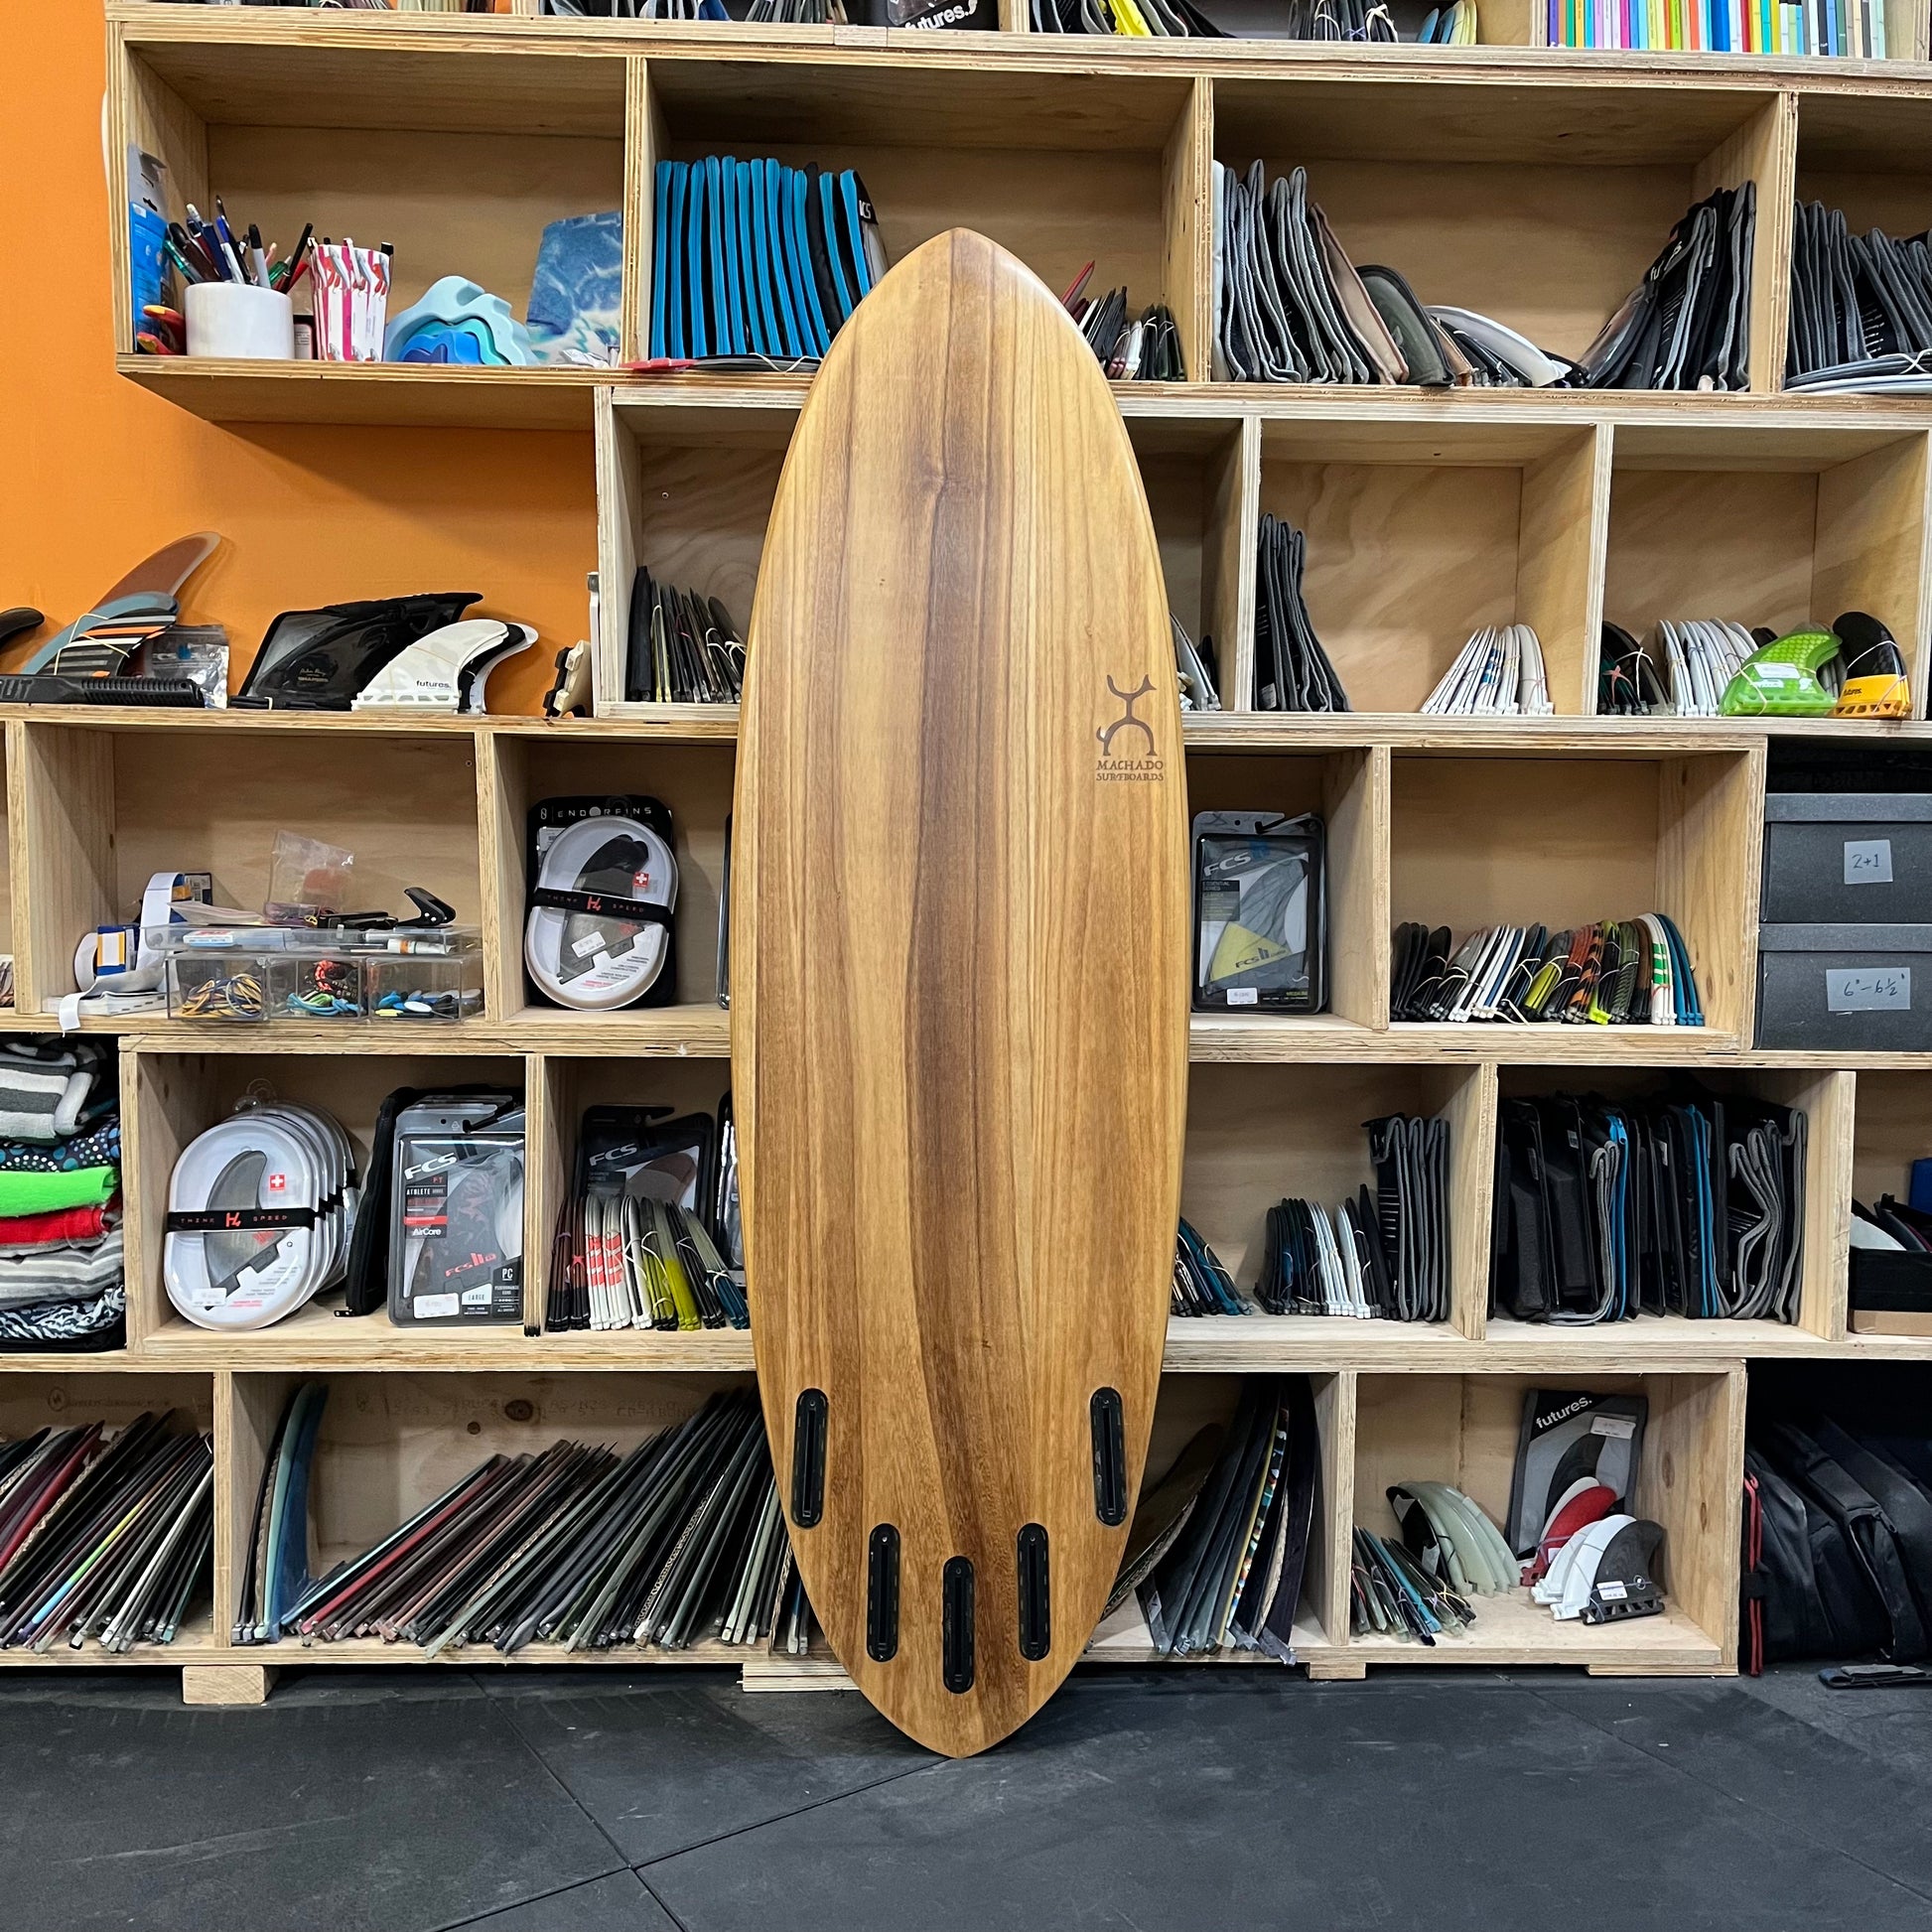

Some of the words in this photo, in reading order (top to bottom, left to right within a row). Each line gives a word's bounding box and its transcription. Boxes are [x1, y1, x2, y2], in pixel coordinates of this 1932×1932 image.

[1096, 759, 1164, 770] MACHADO
[1096, 772, 1164, 781] SURFBOARDS
[1203, 852, 1251, 877] FCS
[1852, 854, 1879, 869] 2+1
[589, 1144, 637, 1167] FCS
[404, 1153, 458, 1180] FCS
[412, 1227, 442, 1236] AirCore
[501, 1268, 513, 1279] PC
[1535, 1396, 1592, 1429] futures.
